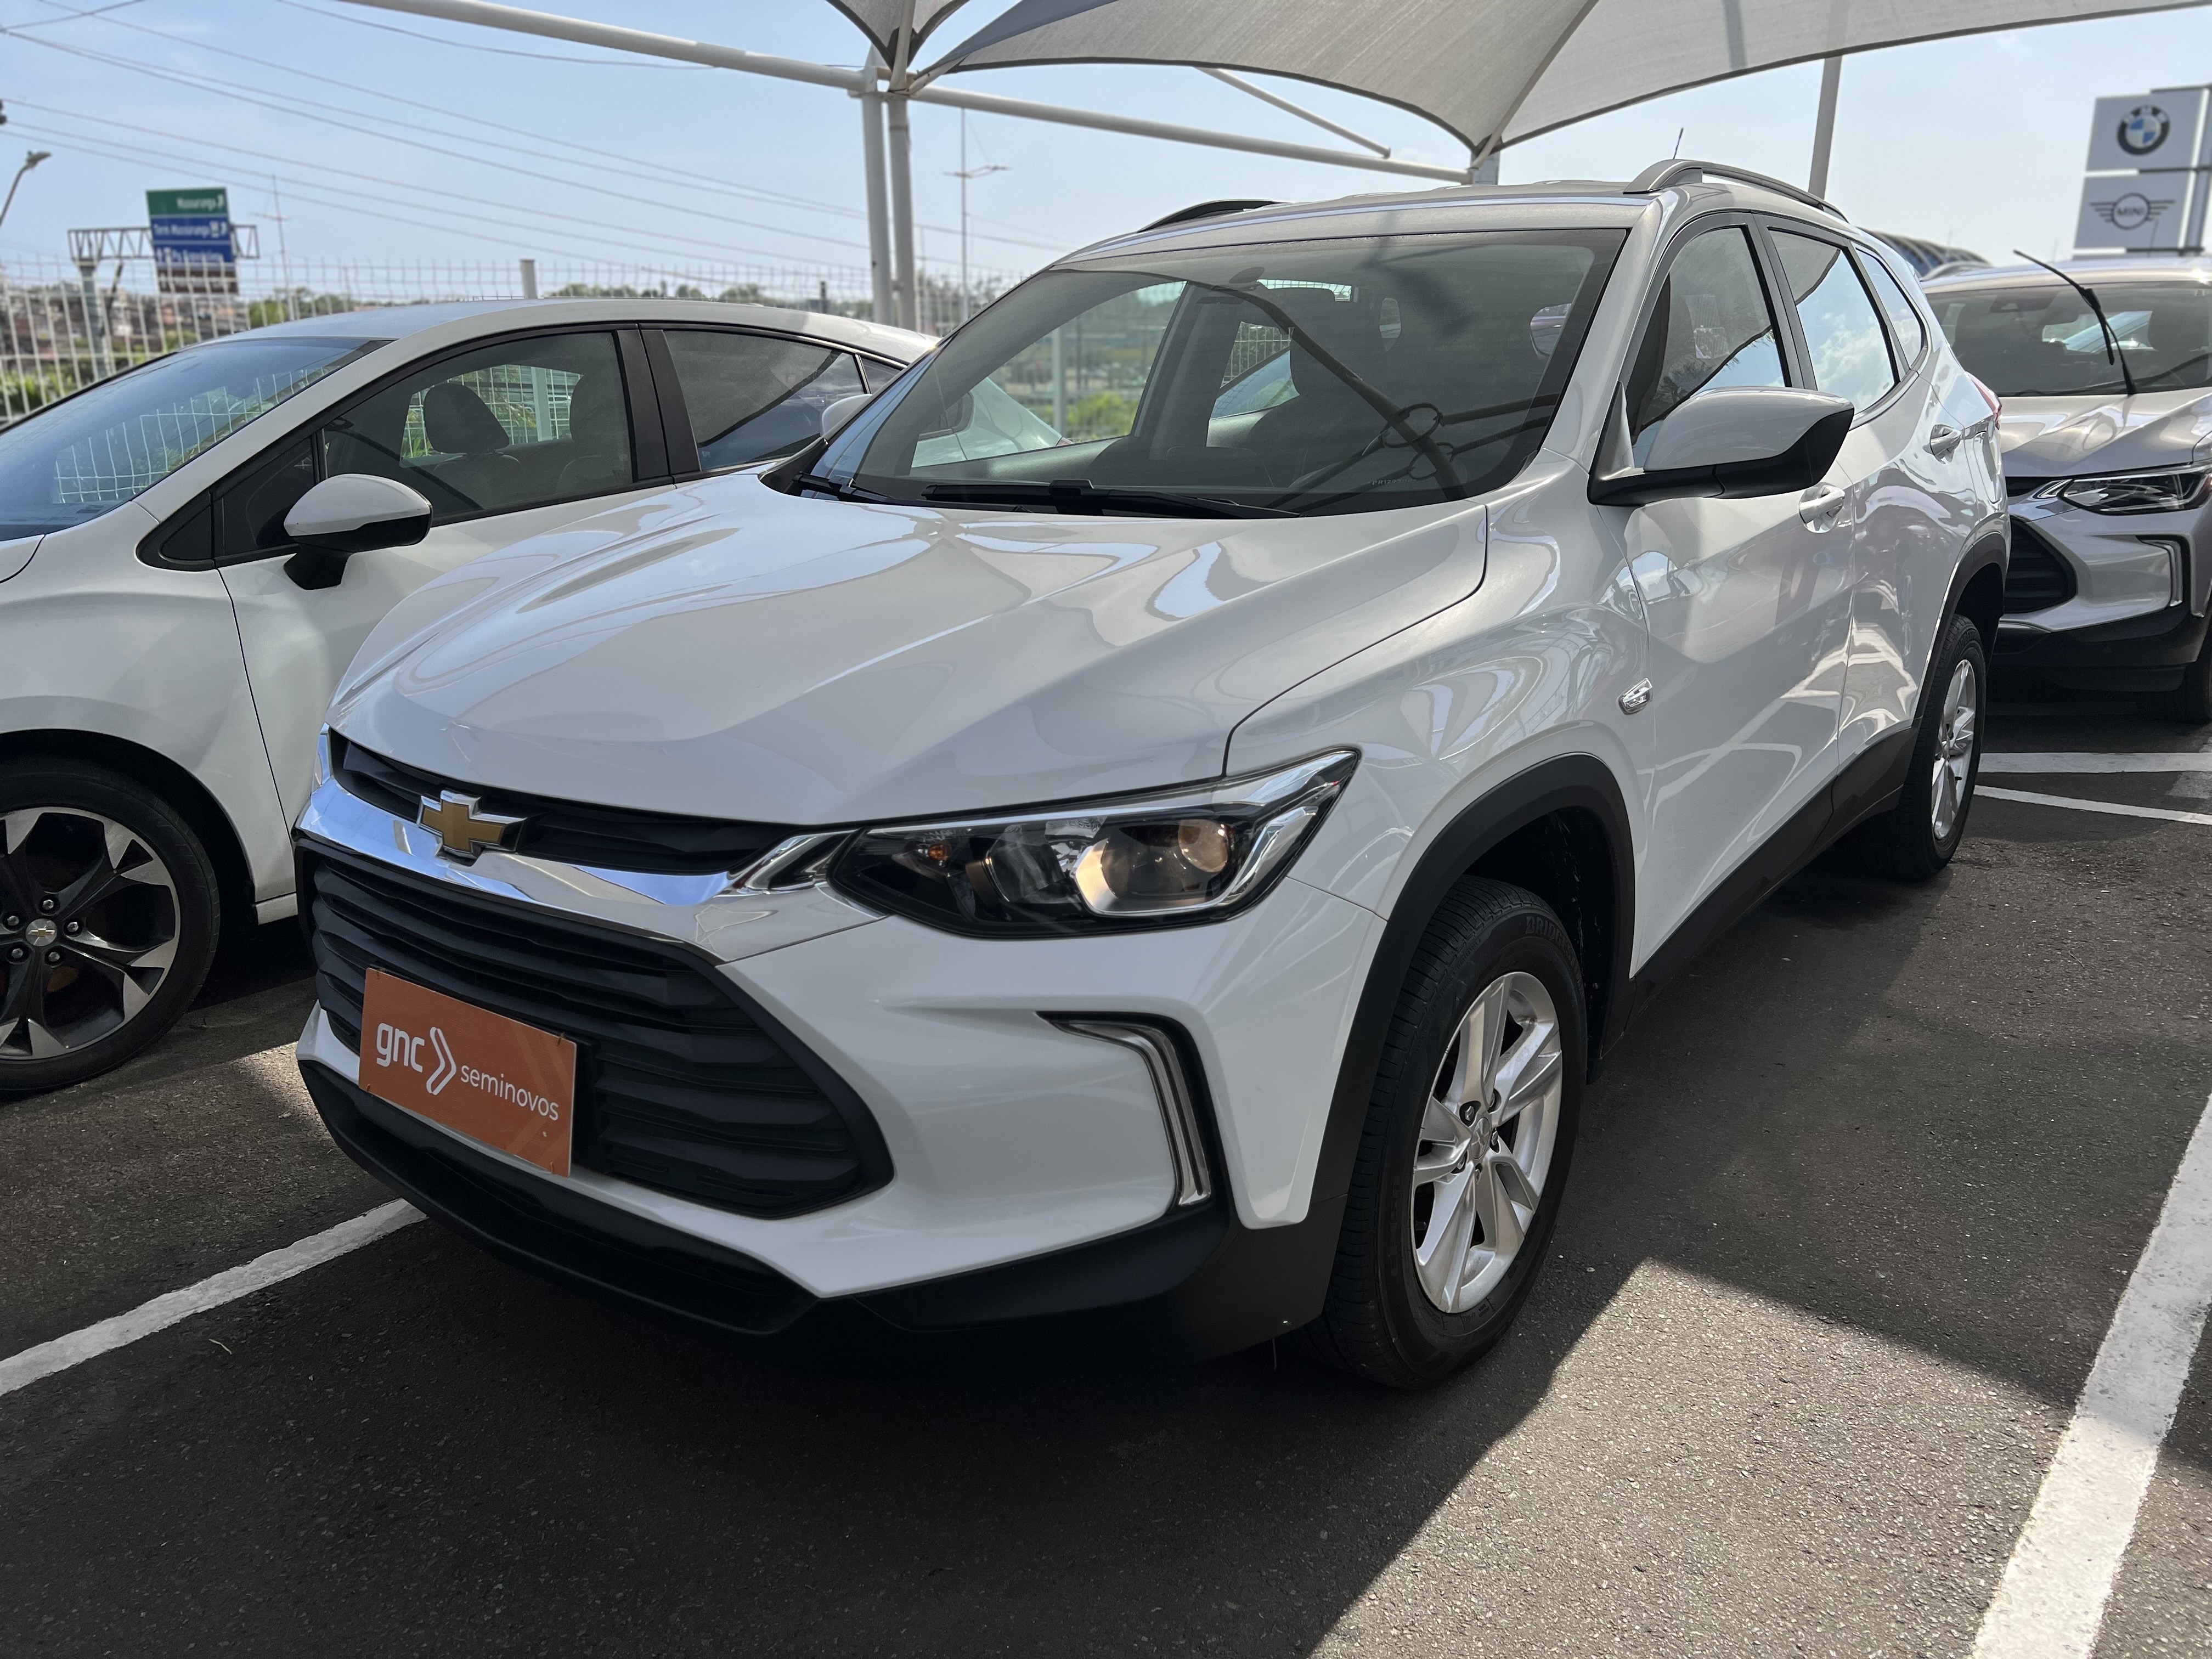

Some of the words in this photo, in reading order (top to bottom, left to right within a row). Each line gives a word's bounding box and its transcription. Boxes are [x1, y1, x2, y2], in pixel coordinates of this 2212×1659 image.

[2117, 207, 2144, 216] MINI
[376, 1023, 425, 1073] gnc
[460, 1064, 559, 1121] seminovos
